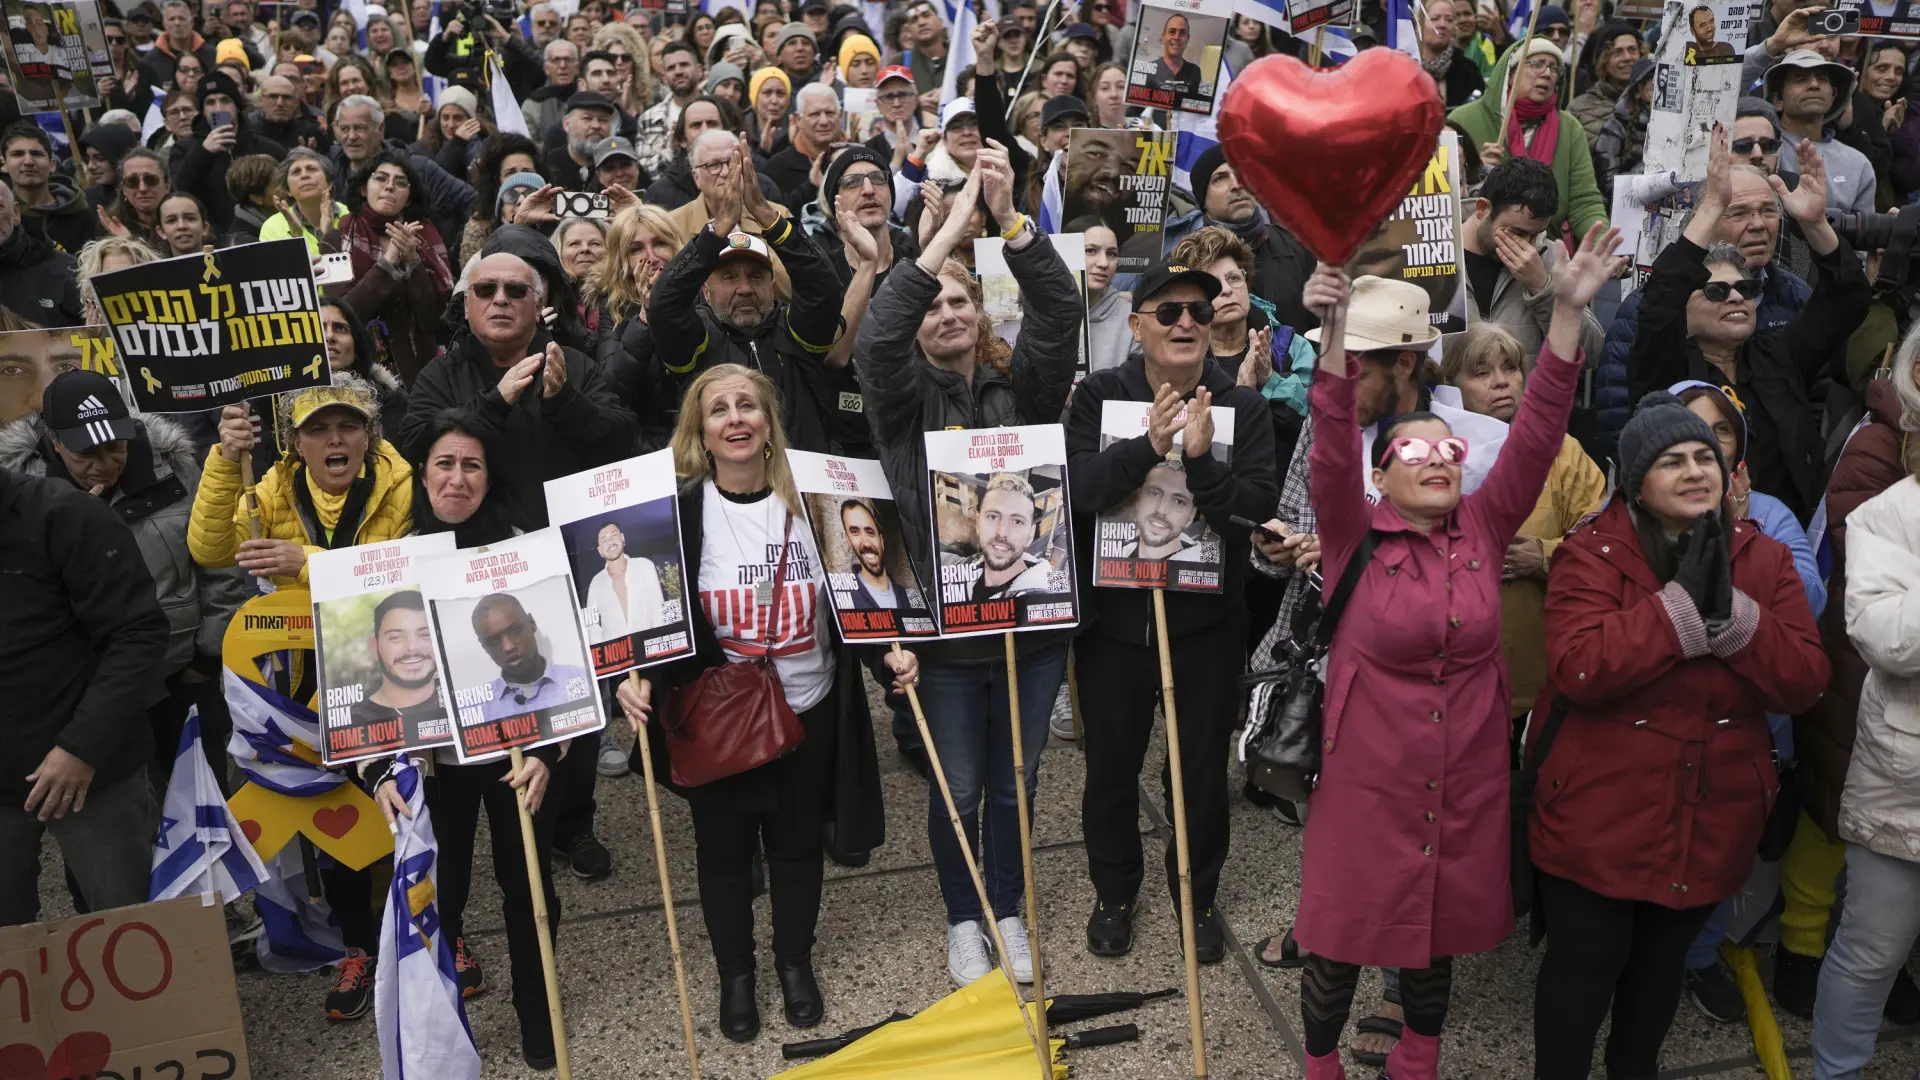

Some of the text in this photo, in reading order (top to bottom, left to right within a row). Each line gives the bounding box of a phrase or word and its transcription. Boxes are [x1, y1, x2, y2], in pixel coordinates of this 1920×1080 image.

[1721, 20, 1742, 29] הביתה
[1133, 60, 1158, 75] BRING
[1131, 72, 1148, 86] HIM
[1128, 86, 1151, 100] HOME
[1152, 88, 1176, 104] NOW!
[1136, 136, 1170, 176] אל
[1119, 175, 1166, 192] תשאירו
[1136, 191, 1164, 208] אותי
[1389, 195, 1453, 221] תשאיר
[1124, 207, 1162, 224] מאחור
[1415, 217, 1455, 242] אותי
[1402, 241, 1456, 266] מאחור
[1403, 264, 1457, 278] אברה מנגיסטו
[102, 277, 314, 325] ושבו כל הבנים
[116, 311, 323, 358] והבנות לגבולם
[70, 335, 119, 375] אל
[209, 364, 292, 397] #עדהחטוףהאחרון
[77, 407, 109, 419] adidas
[971, 433, 1019, 447] אלקנה בוחבוט
[968, 444, 1024, 458] ELKANA BOHBOT
[990, 458, 1005, 470] (34)
[594, 468, 623, 486] אליה כהן
[589, 478, 630, 498] ELIYA COHEN
[604, 493, 617, 507] (27)
[1101, 521, 1136, 540] BRING
[360, 545, 401, 562] עומר ונקרט
[1100, 540, 1124, 558] HIM
[353, 556, 410, 577] OMER WENKERT
[470, 551, 519, 571] אברה מנגיסטו
[1099, 559, 1168, 580] HOME NOW!
[364, 574, 386, 590] (23)
[465, 560, 529, 584] AVERA MANGISTO
[828, 572, 859, 591] BRING
[941, 563, 980, 584] BRING
[1179, 575, 1219, 586] FAMILIES FORUM
[491, 577, 508, 591] (36)
[943, 583, 967, 604] HIM
[833, 591, 855, 610] HIM
[840, 609, 896, 630] HOME NOW!
[944, 599, 1016, 625] HOME NOW!
[1028, 607, 1073, 620] FAMILIES FORUM
[603, 634, 634, 664] NOW!
[326, 683, 364, 708] BRING
[455, 682, 494, 708] BRING
[328, 706, 352, 728] HIM
[458, 704, 485, 728] HIM
[552, 711, 597, 731] FAMILIES FORUM
[329, 715, 405, 751] HOME NOW!
[418, 725, 445, 739] FAMILIES
[464, 723, 501, 748] HOME
[501, 712, 539, 740] NOW!
